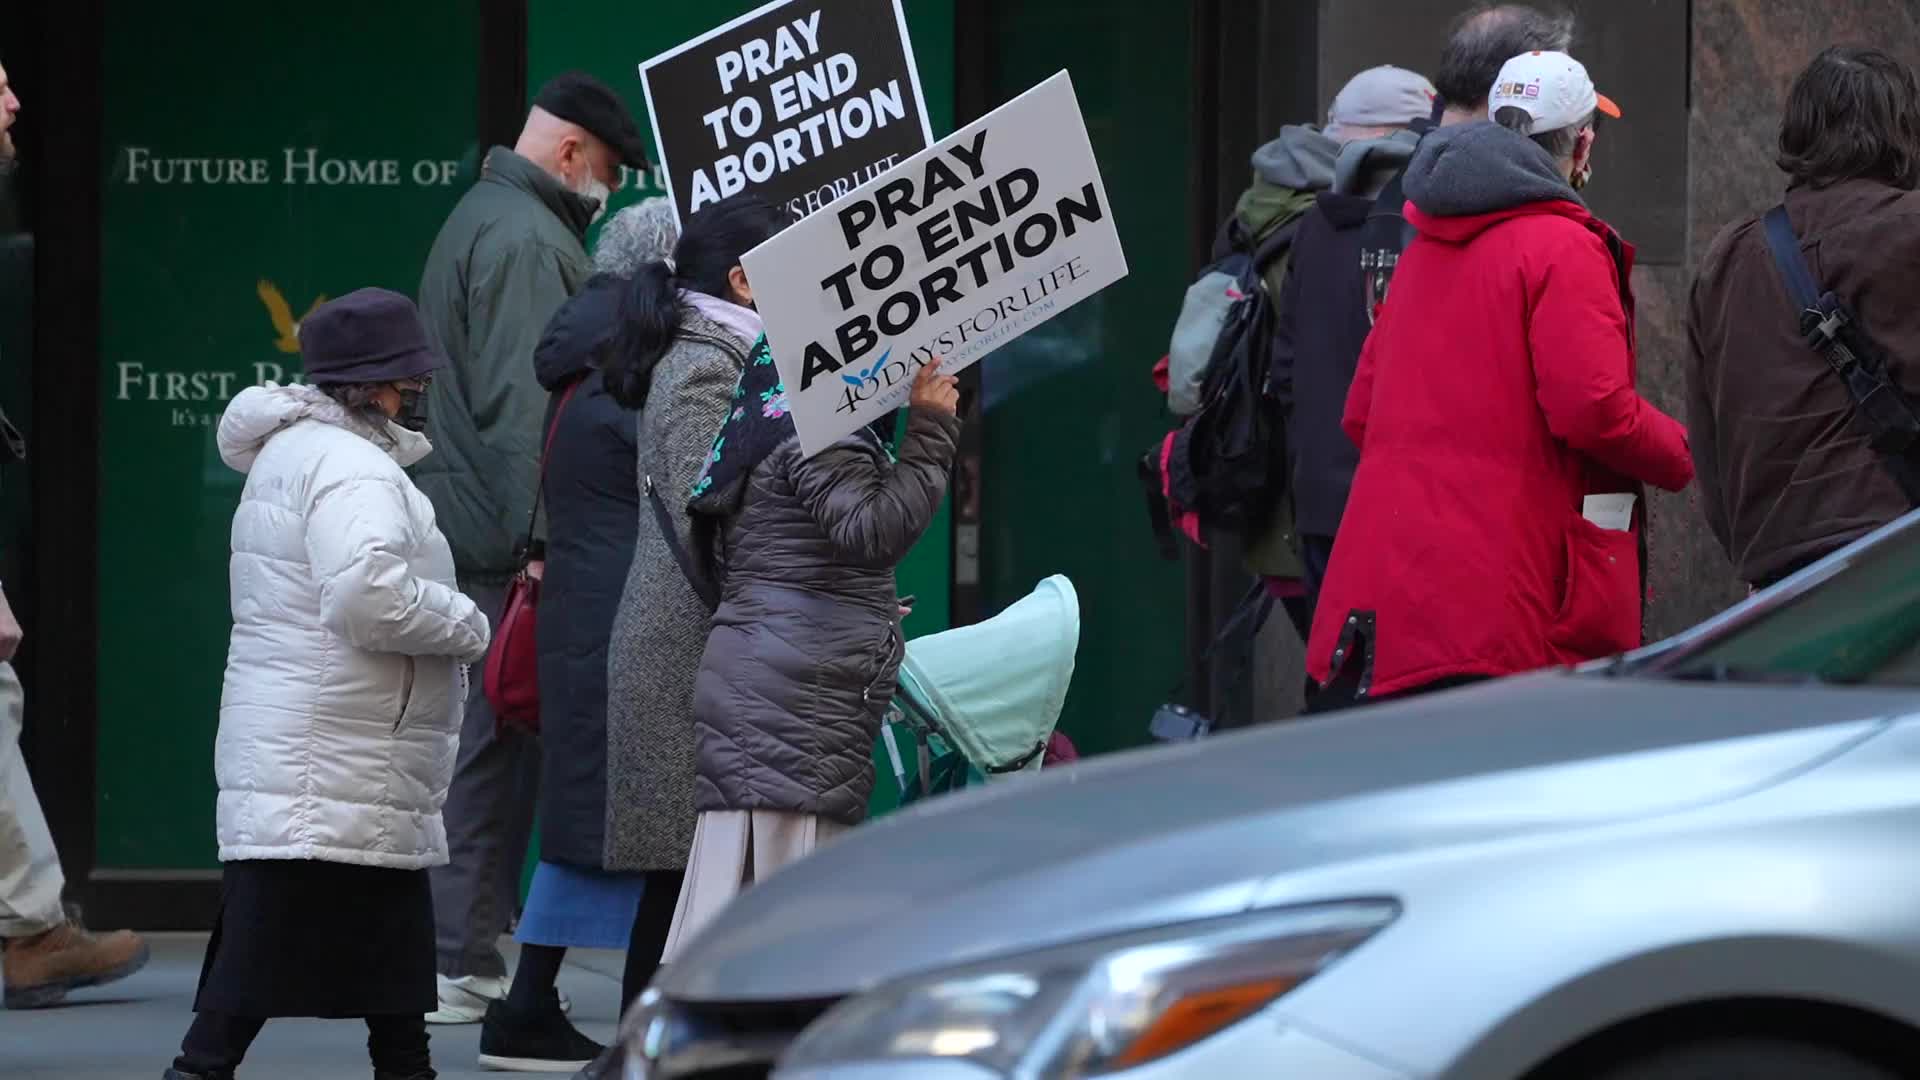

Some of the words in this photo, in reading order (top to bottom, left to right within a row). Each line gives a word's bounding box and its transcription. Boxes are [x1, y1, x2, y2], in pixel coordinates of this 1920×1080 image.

[703, 96, 763, 150] TO
[769, 53, 858, 122] END
[715, 9, 821, 95] PRAY
[125, 148, 270, 185] FUTURE
[282, 148, 401, 185] HOME
[690, 79, 906, 215] ABORTION
[837, 128, 988, 250] PRAY
[800, 182, 1103, 392] ABORTION
[820, 244, 905, 311] TO
[916, 167, 1040, 262] END
[116, 361, 236, 400] FIRST
[835, 376, 880, 414] 40
[881, 331, 954, 387] DAYS
[957, 295, 1025, 344] FOR
[1022, 256, 1090, 306] LIFE
